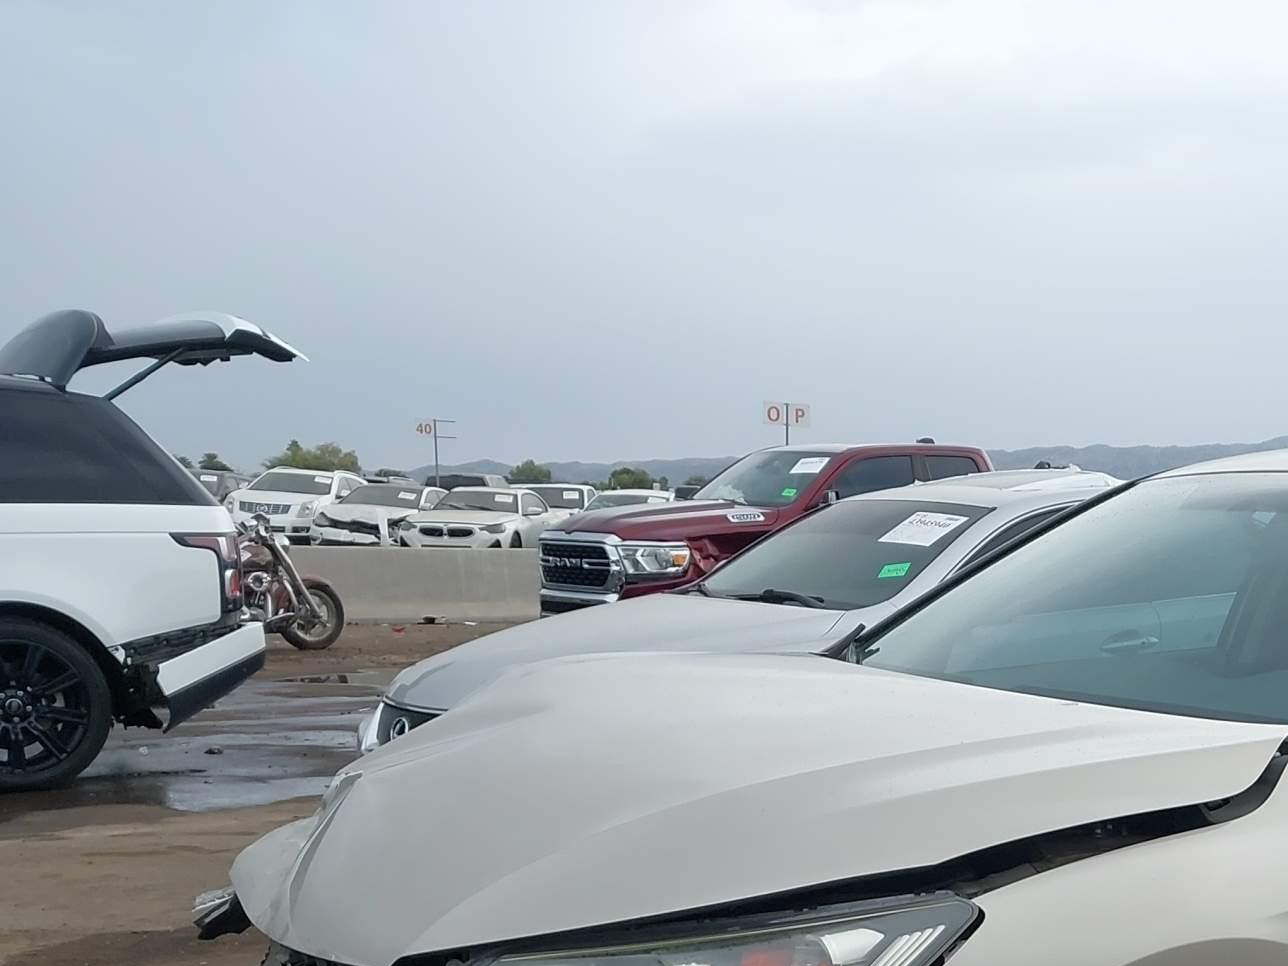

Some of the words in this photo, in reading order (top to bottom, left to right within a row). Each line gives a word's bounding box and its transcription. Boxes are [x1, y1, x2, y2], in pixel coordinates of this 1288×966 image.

[767, 405, 781, 422] O
[794, 407, 806, 424] P
[415, 423, 433, 435] 40
[549, 557, 581, 568] RAM
